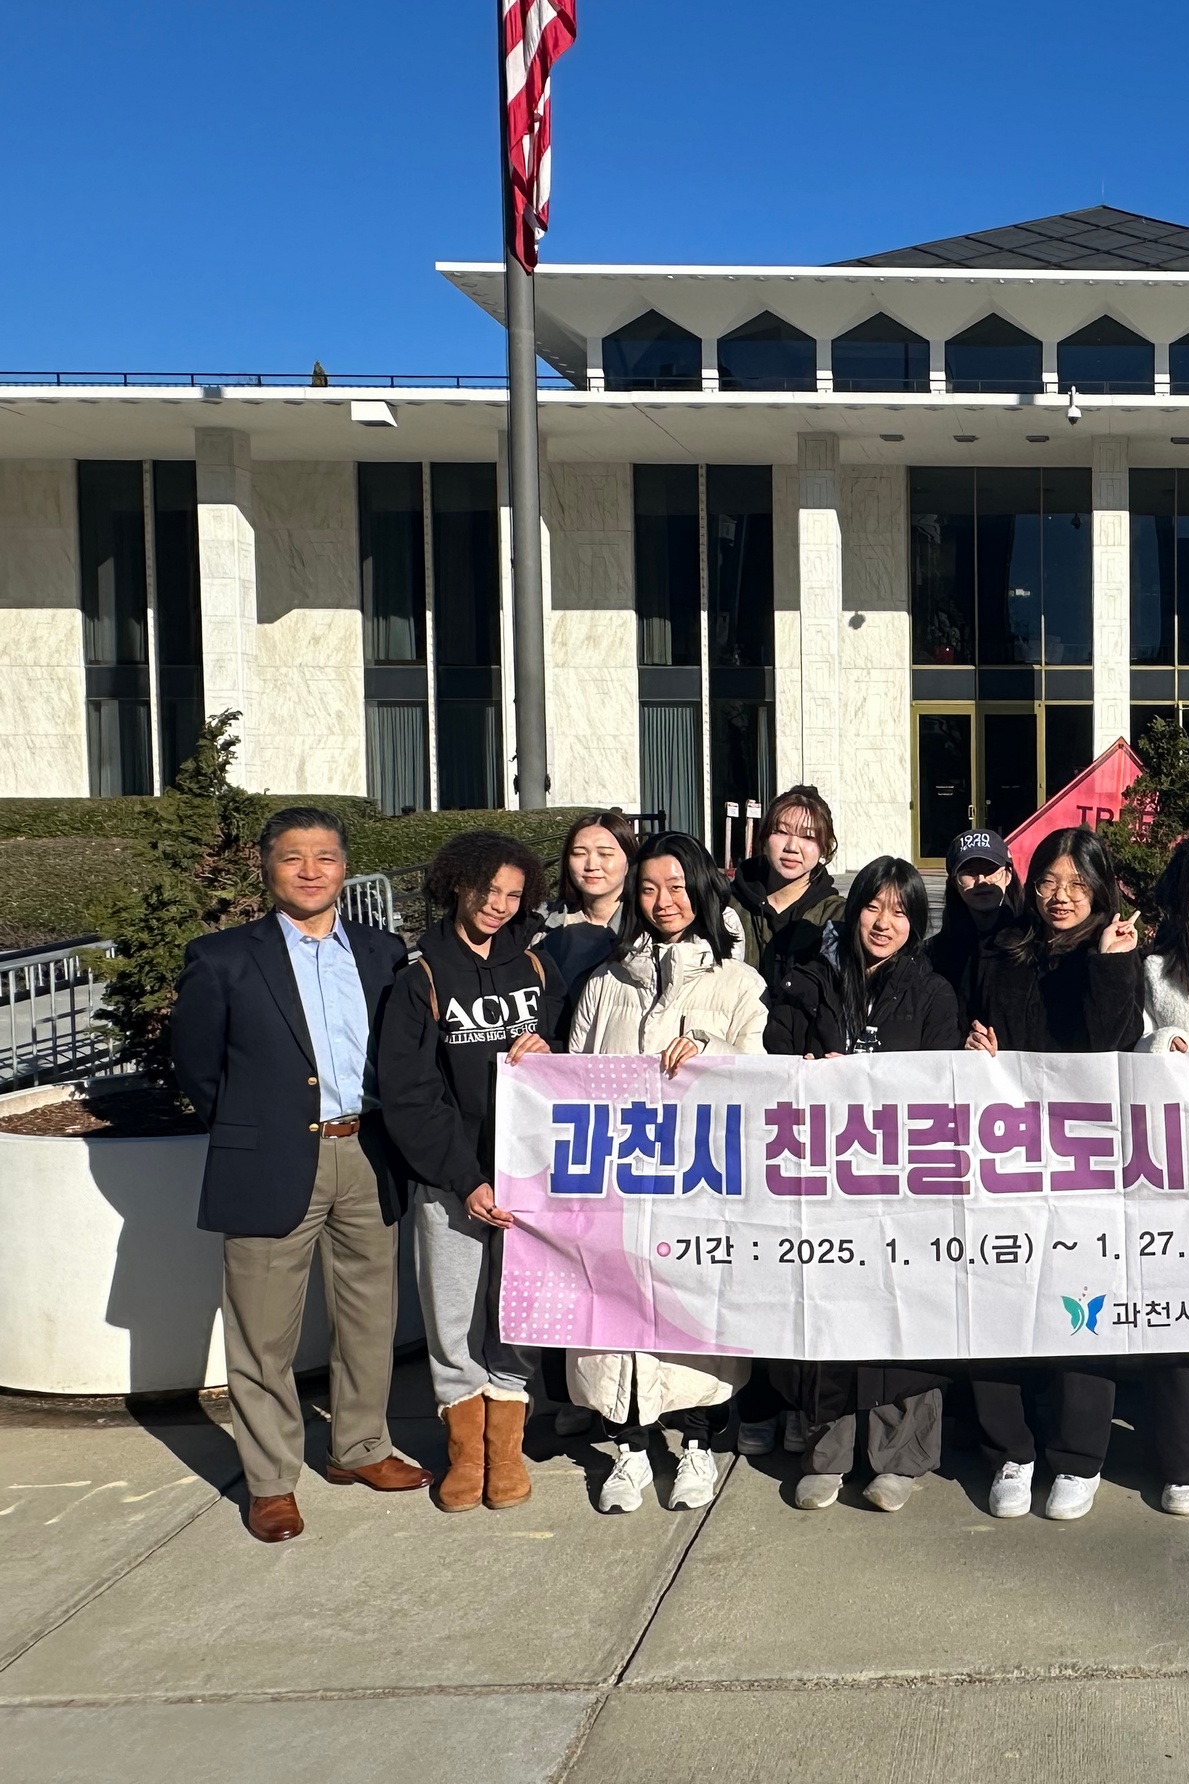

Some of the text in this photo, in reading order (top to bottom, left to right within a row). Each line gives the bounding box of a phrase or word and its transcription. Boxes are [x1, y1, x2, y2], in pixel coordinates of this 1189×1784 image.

[551, 1101, 742, 1196] 과천시
[765, 1101, 1184, 1196] 친선결연도시
[675, 1235, 735, 1265] 기간
[778, 1238, 866, 1266] 2025.
[886, 1238, 910, 1266] 1.
[930, 1234, 1035, 1265] 10.(금)
[1096, 1233, 1120, 1260] 1.
